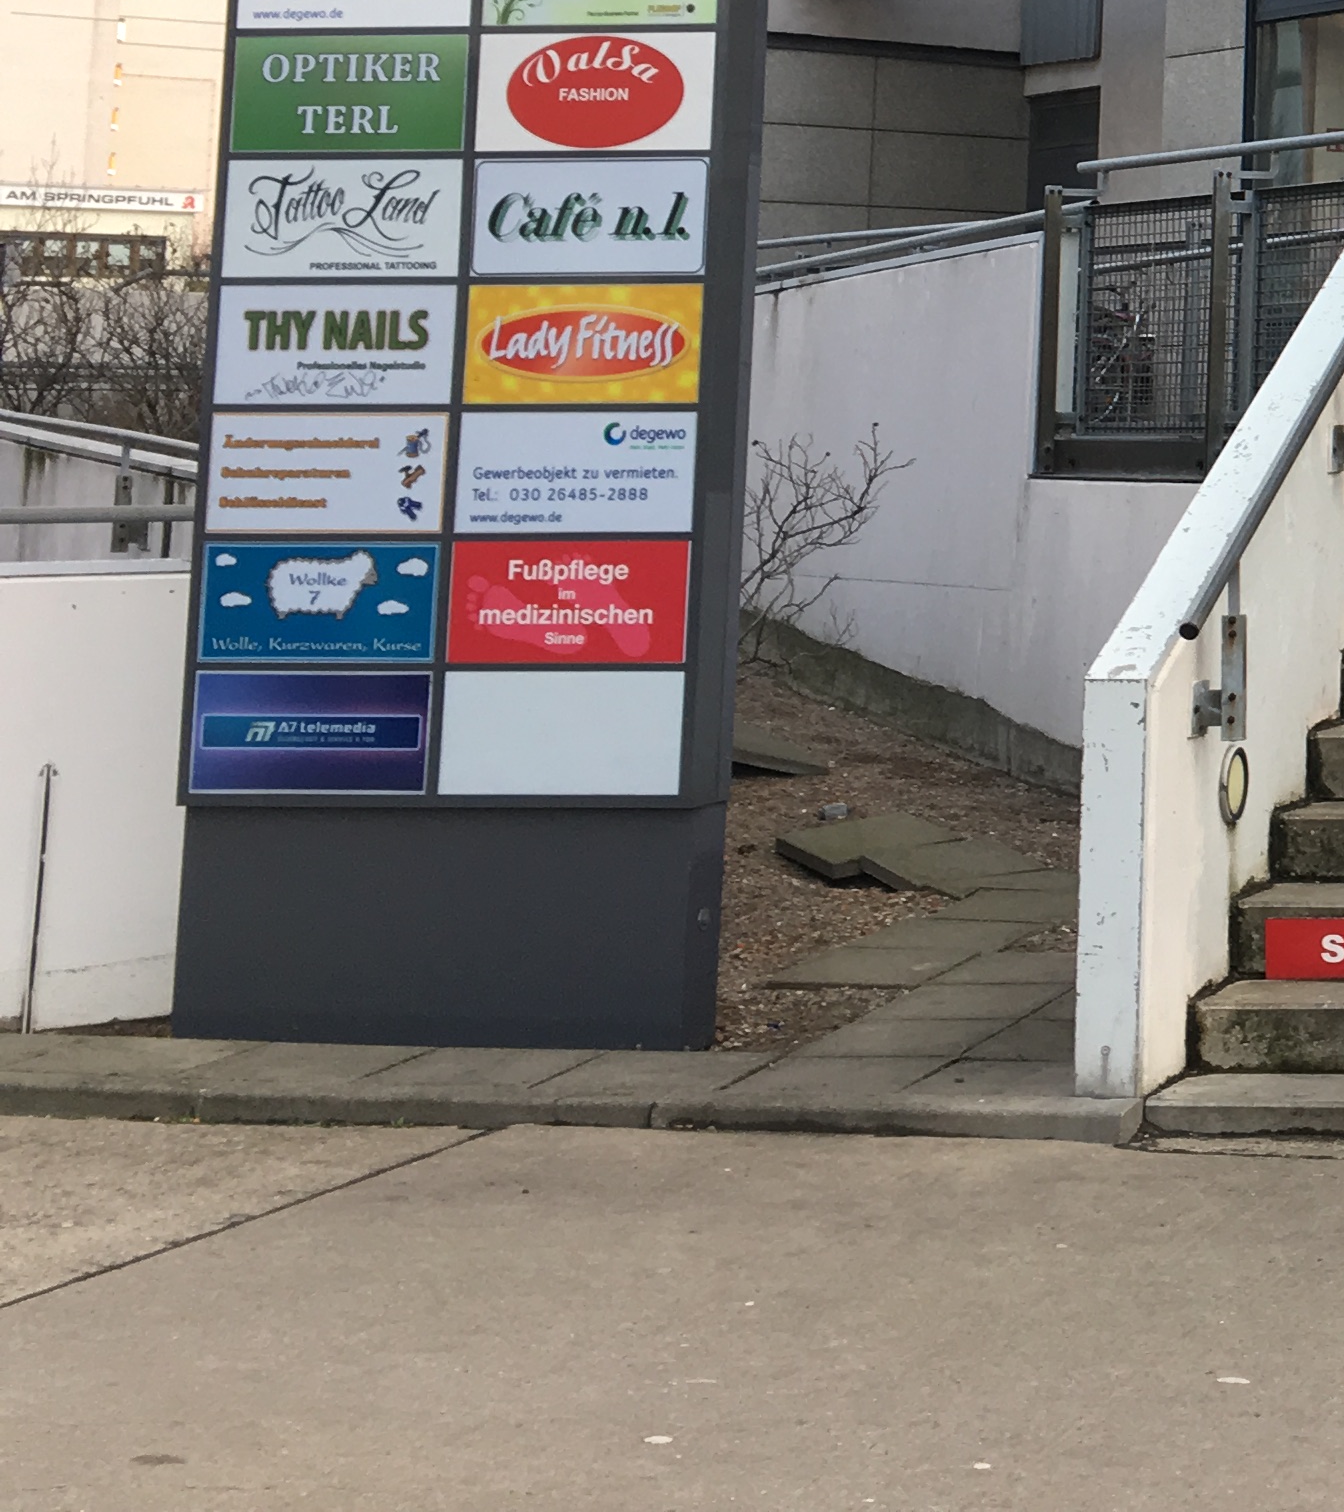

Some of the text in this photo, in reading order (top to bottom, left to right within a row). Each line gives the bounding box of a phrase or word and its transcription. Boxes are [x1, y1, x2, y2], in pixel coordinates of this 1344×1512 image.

[252, 8, 343, 22] www.degewo.de
[262, 52, 442, 83] OPTIKER
[558, 88, 629, 102] FASHION
[297, 104, 399, 135] TERL
[6, 190, 37, 201] AM
[43, 191, 174, 207] SPRINGPFUHL
[248, 165, 441, 242] Tattoo Land
[487, 191, 603, 243] Café
[309, 260, 437, 271] PROFESSIONAL TATTOOING
[244, 309, 429, 351] THY NAILS
[630, 425, 687, 444] degewo
[472, 466, 679, 483] Gewerbeobjekt zu vermieten.
[509, 488, 541, 502] 030
[547, 487, 649, 502] 26485-2888
[469, 511, 563, 526] www.degewo.de
[289, 572, 347, 587] Wollke
[507, 559, 629, 585] Fußpflege
[308, 590, 321, 606] 7
[558, 587, 576, 600] im
[478, 603, 654, 625] medizinischen
[211, 637, 423, 653] Wolle, Kurzwaren, Kurse
[544, 631, 585, 645] Sinne
[300, 720, 376, 735] telemedia
